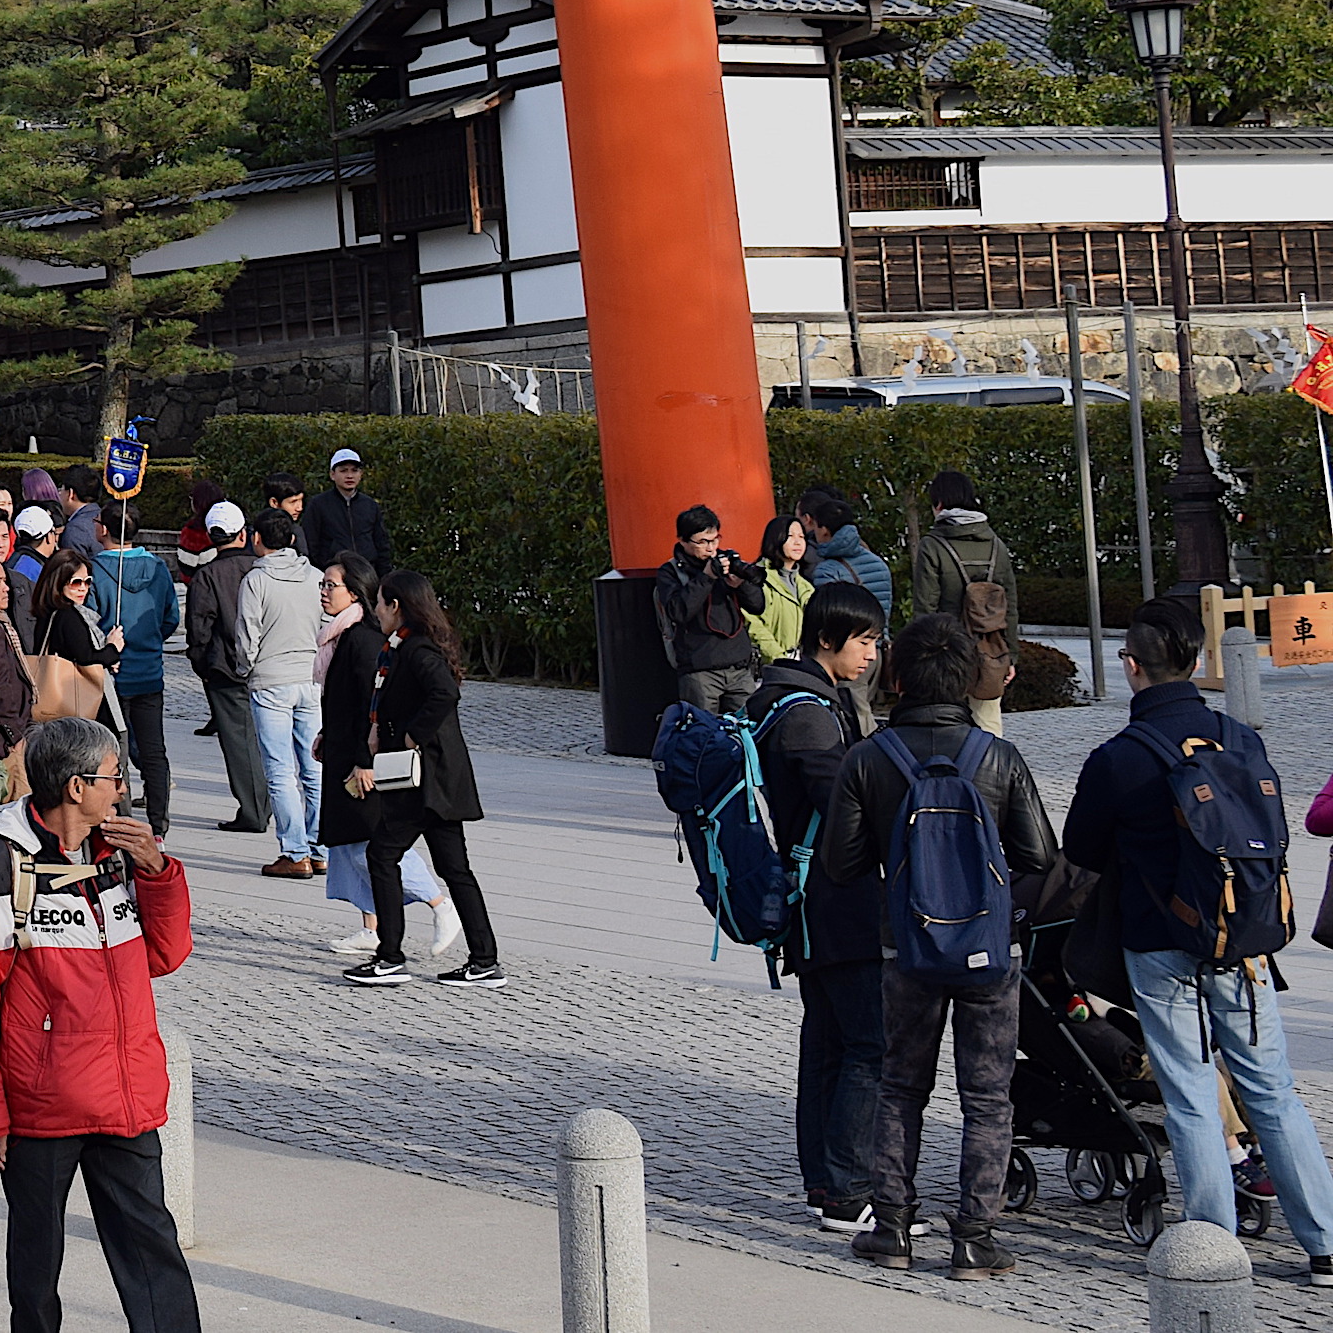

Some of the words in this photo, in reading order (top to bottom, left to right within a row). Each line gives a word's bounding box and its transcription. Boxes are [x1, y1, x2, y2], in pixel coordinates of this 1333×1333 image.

[1292, 616, 1317, 646] 車
[31, 909, 86, 927] LECOQ
[113, 899, 137, 921] SPO
